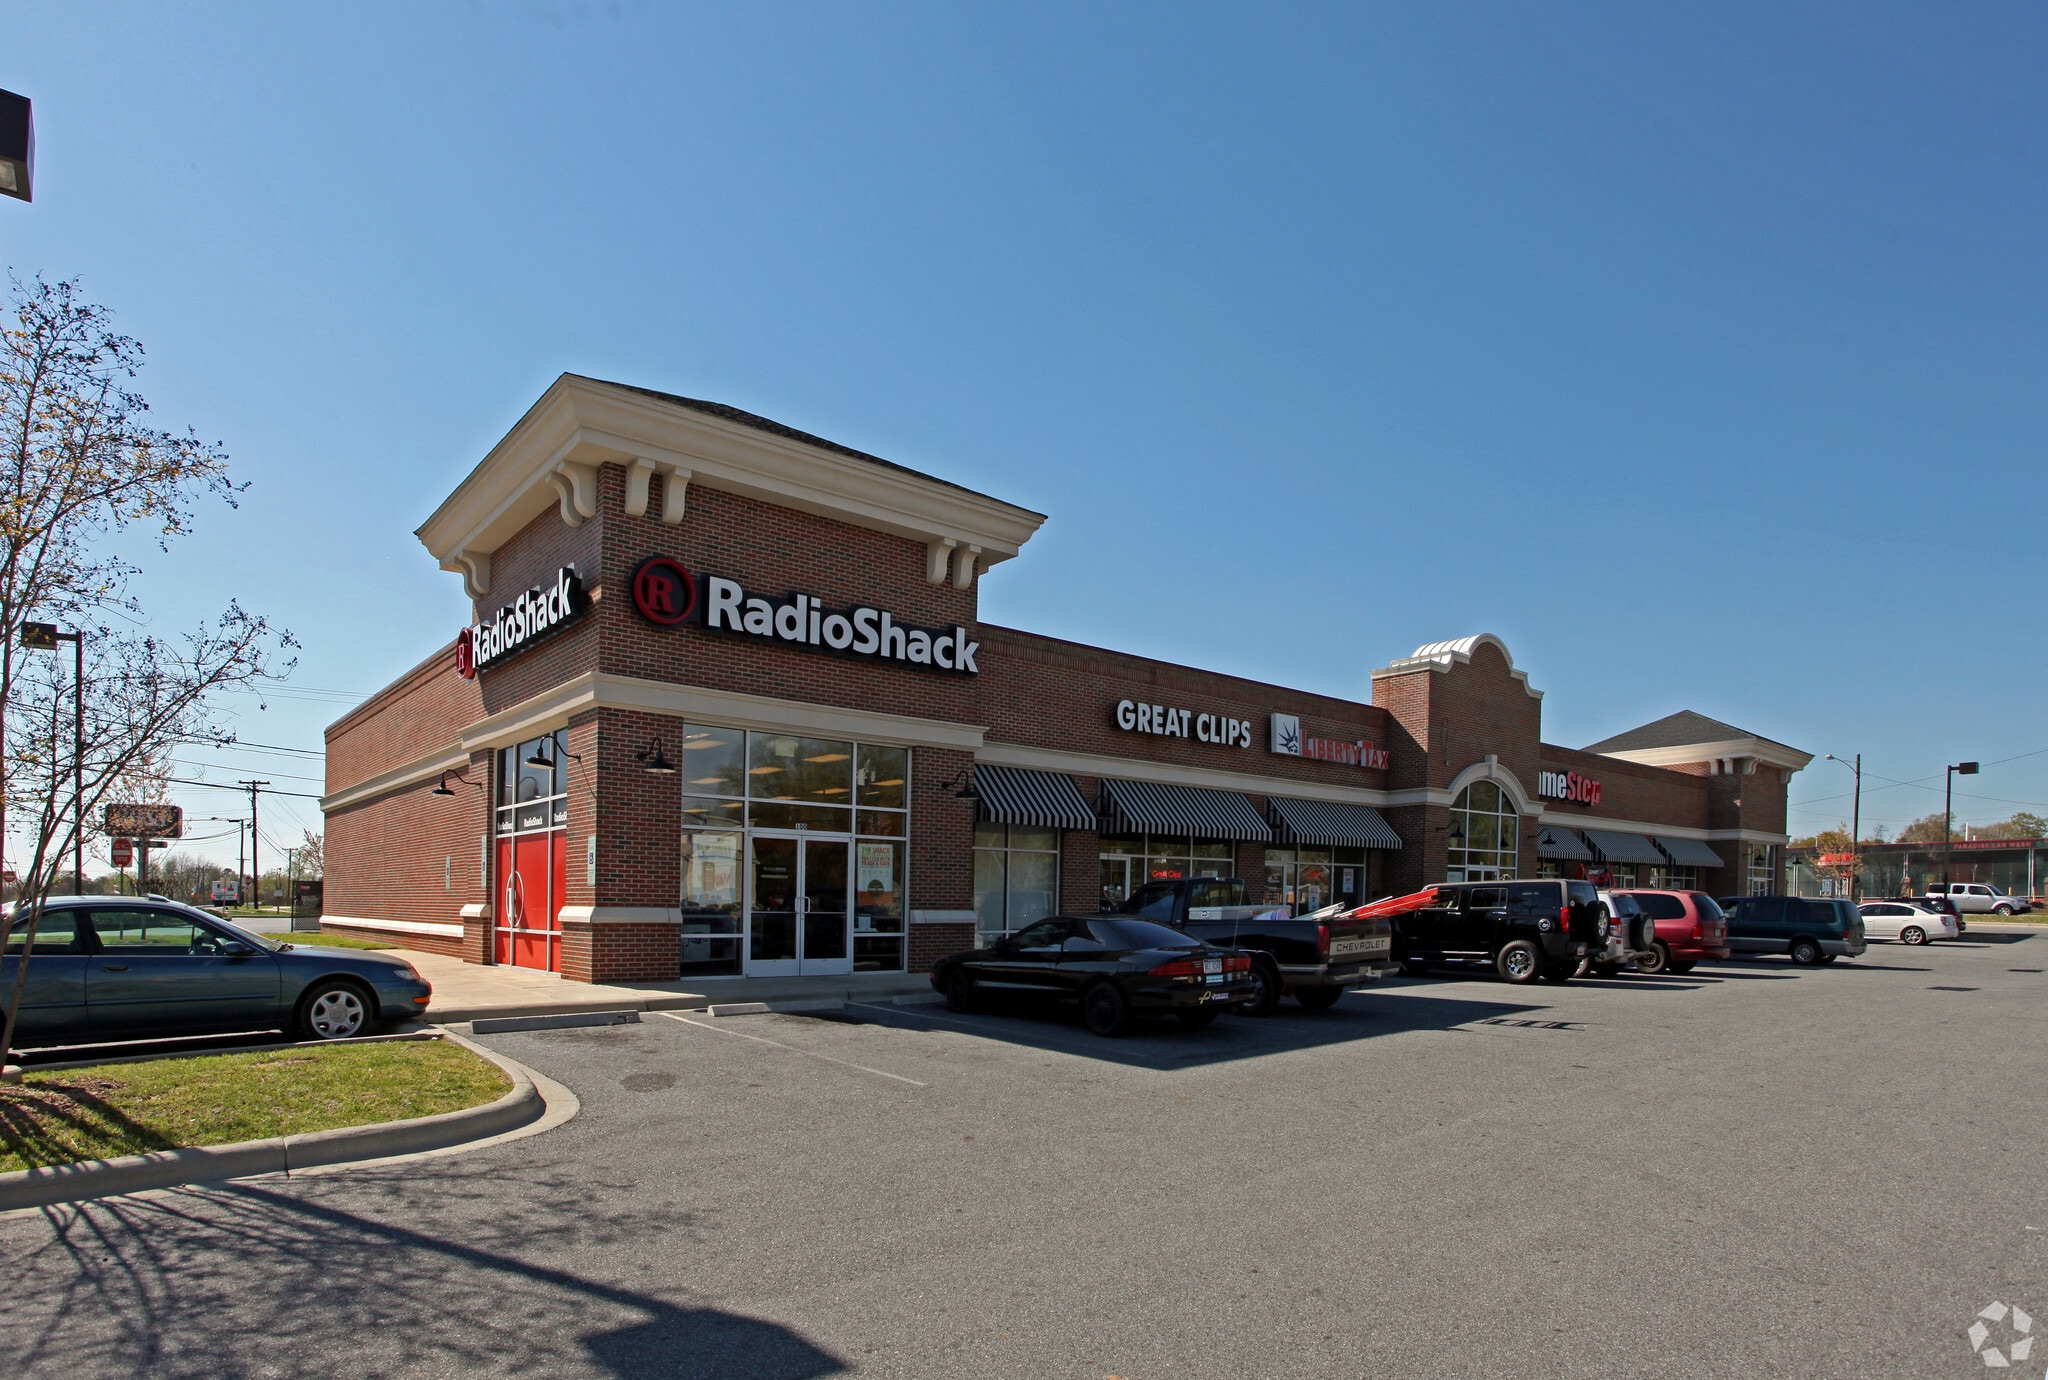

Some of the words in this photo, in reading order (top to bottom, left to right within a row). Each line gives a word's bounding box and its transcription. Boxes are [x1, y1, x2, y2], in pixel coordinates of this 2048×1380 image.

[473, 567, 571, 669] RadioShack
[708, 576, 979, 673] RadioShack
[1117, 699, 1191, 738] GREAT
[1196, 713, 1251, 748] CLIPS
[1302, 729, 1360, 765] LIBERTY
[1362, 740, 1389, 769] TAX
[1336, 940, 1384, 952] CHEVROLET
